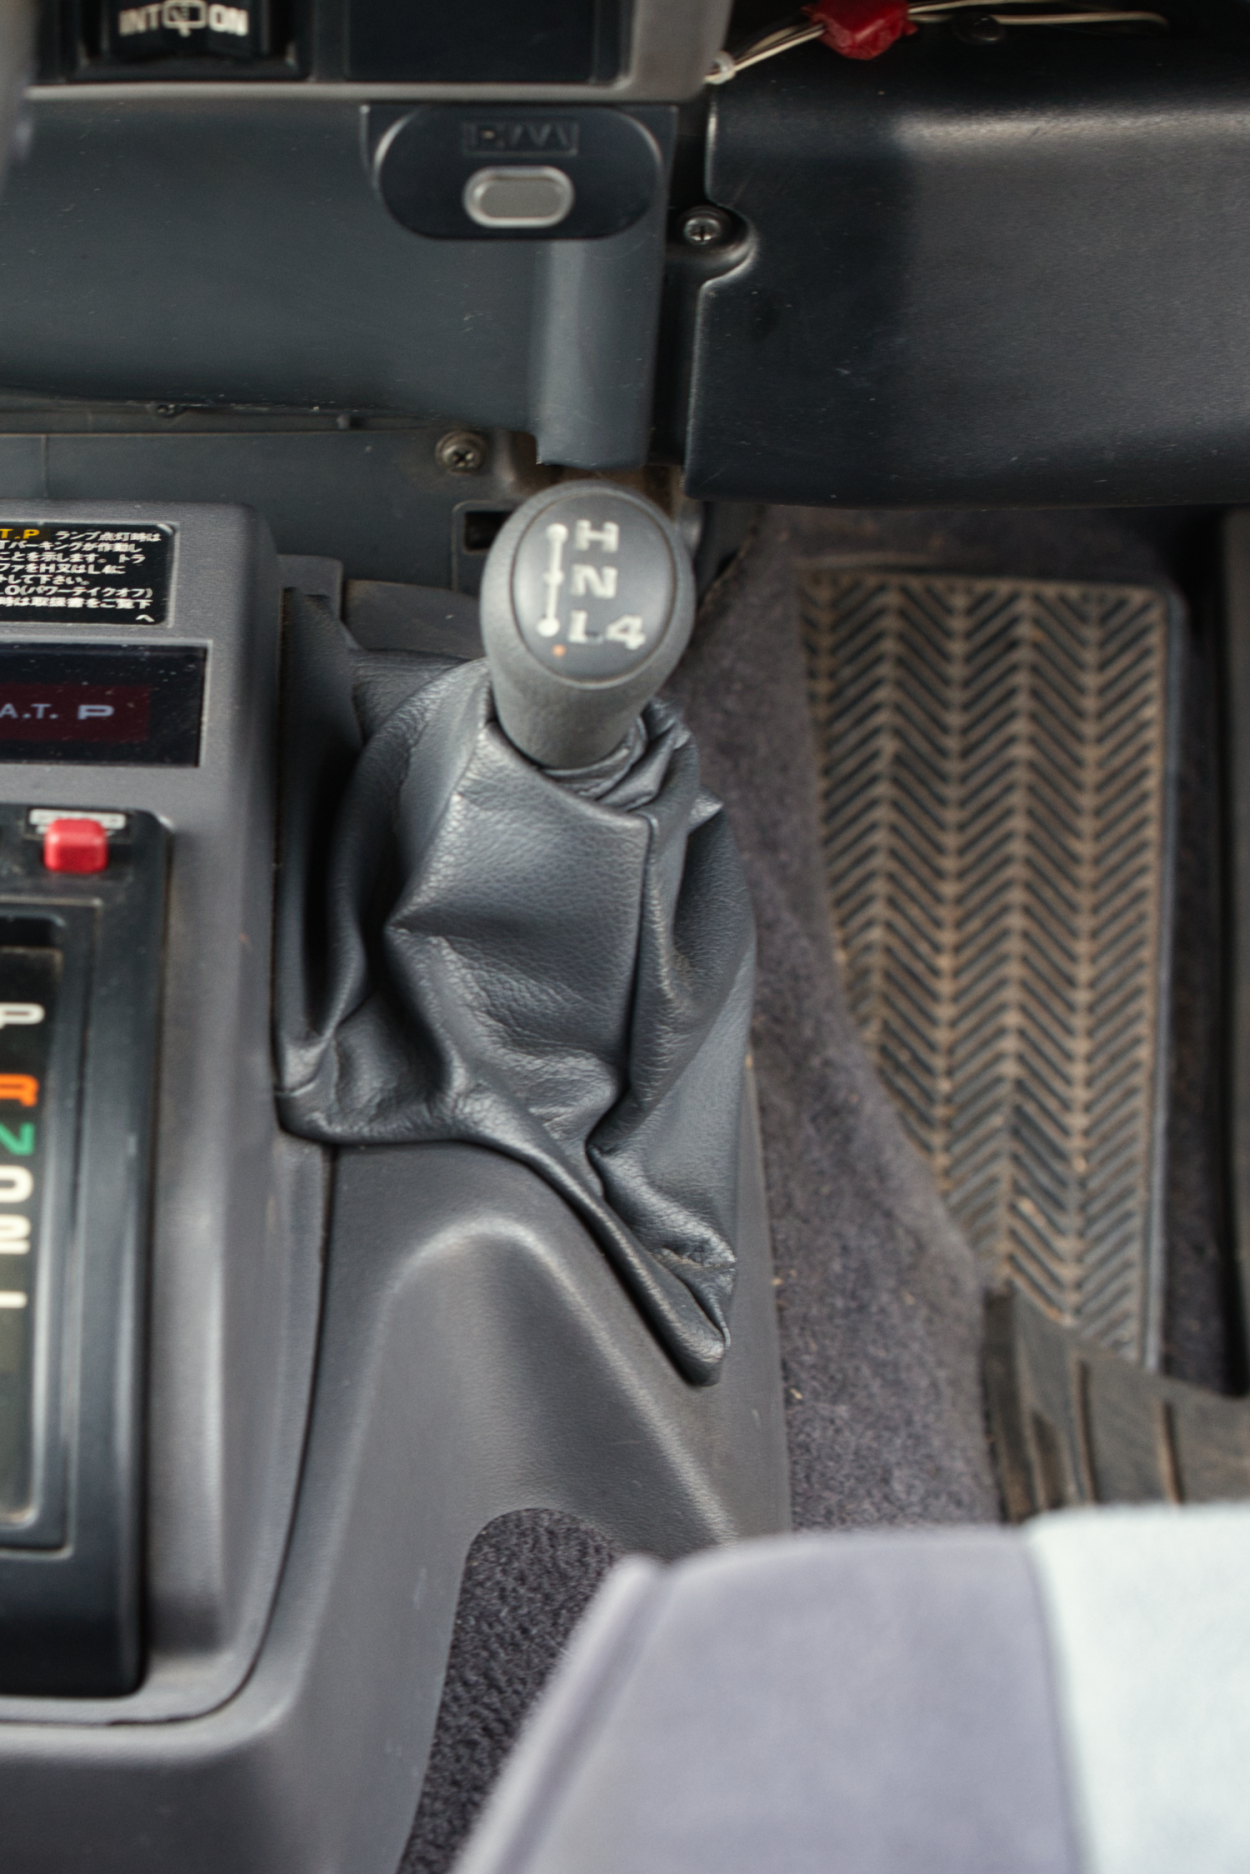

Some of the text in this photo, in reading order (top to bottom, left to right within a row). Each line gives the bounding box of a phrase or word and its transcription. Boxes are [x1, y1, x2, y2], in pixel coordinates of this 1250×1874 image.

[119, 4, 248, 37] INT ON
[575, 519, 619, 553] H
[570, 564, 618, 598] N
[77, 704, 115, 720] P
